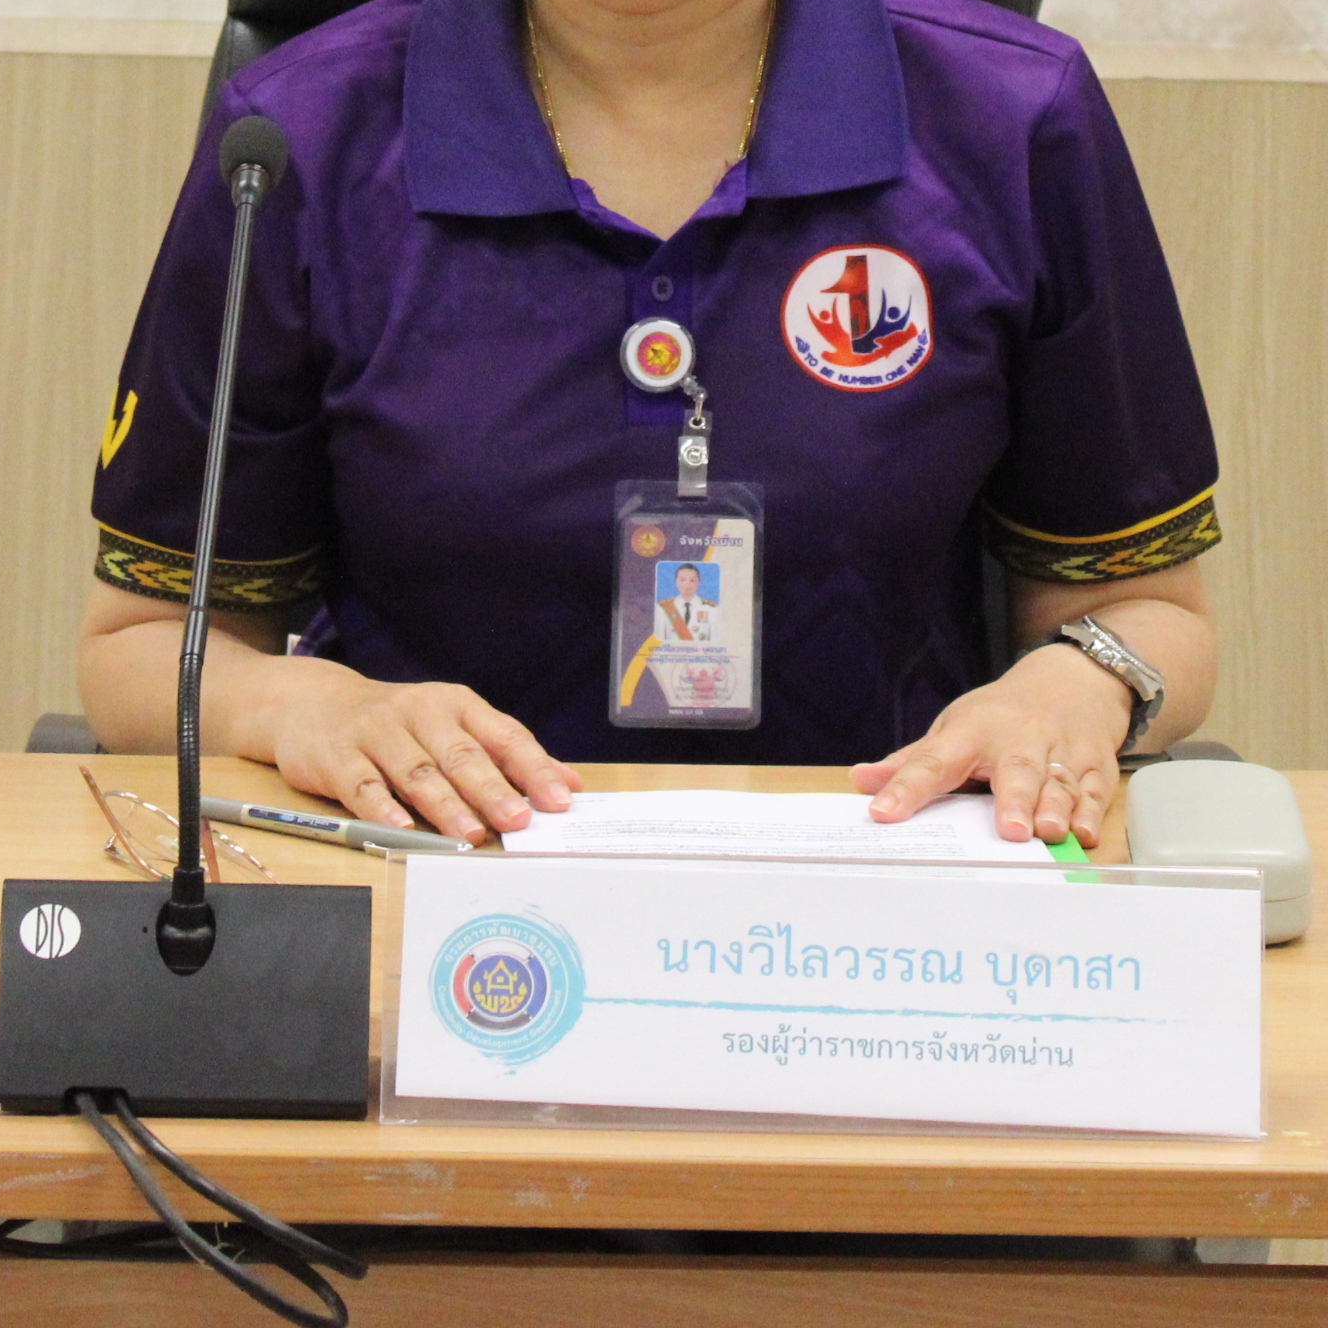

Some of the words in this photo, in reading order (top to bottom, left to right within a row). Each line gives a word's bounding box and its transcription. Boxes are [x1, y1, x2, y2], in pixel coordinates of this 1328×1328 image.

[804, 352, 818, 368] TO
[819, 366, 836, 380] BE
[838, 373, 884, 385] NUMBER
[885, 365, 908, 382] ONE
[906, 345, 926, 368] NAN
[34, 903, 66, 959] DIS
[656, 921, 965, 984] นางวิไลวรรณ
[984, 949, 1143, 1006] บุดาสา
[466, 1030, 530, 1049] Development
[721, 1024, 1075, 1068] รองผู้ว่าราชการจังหวัดน่าน
